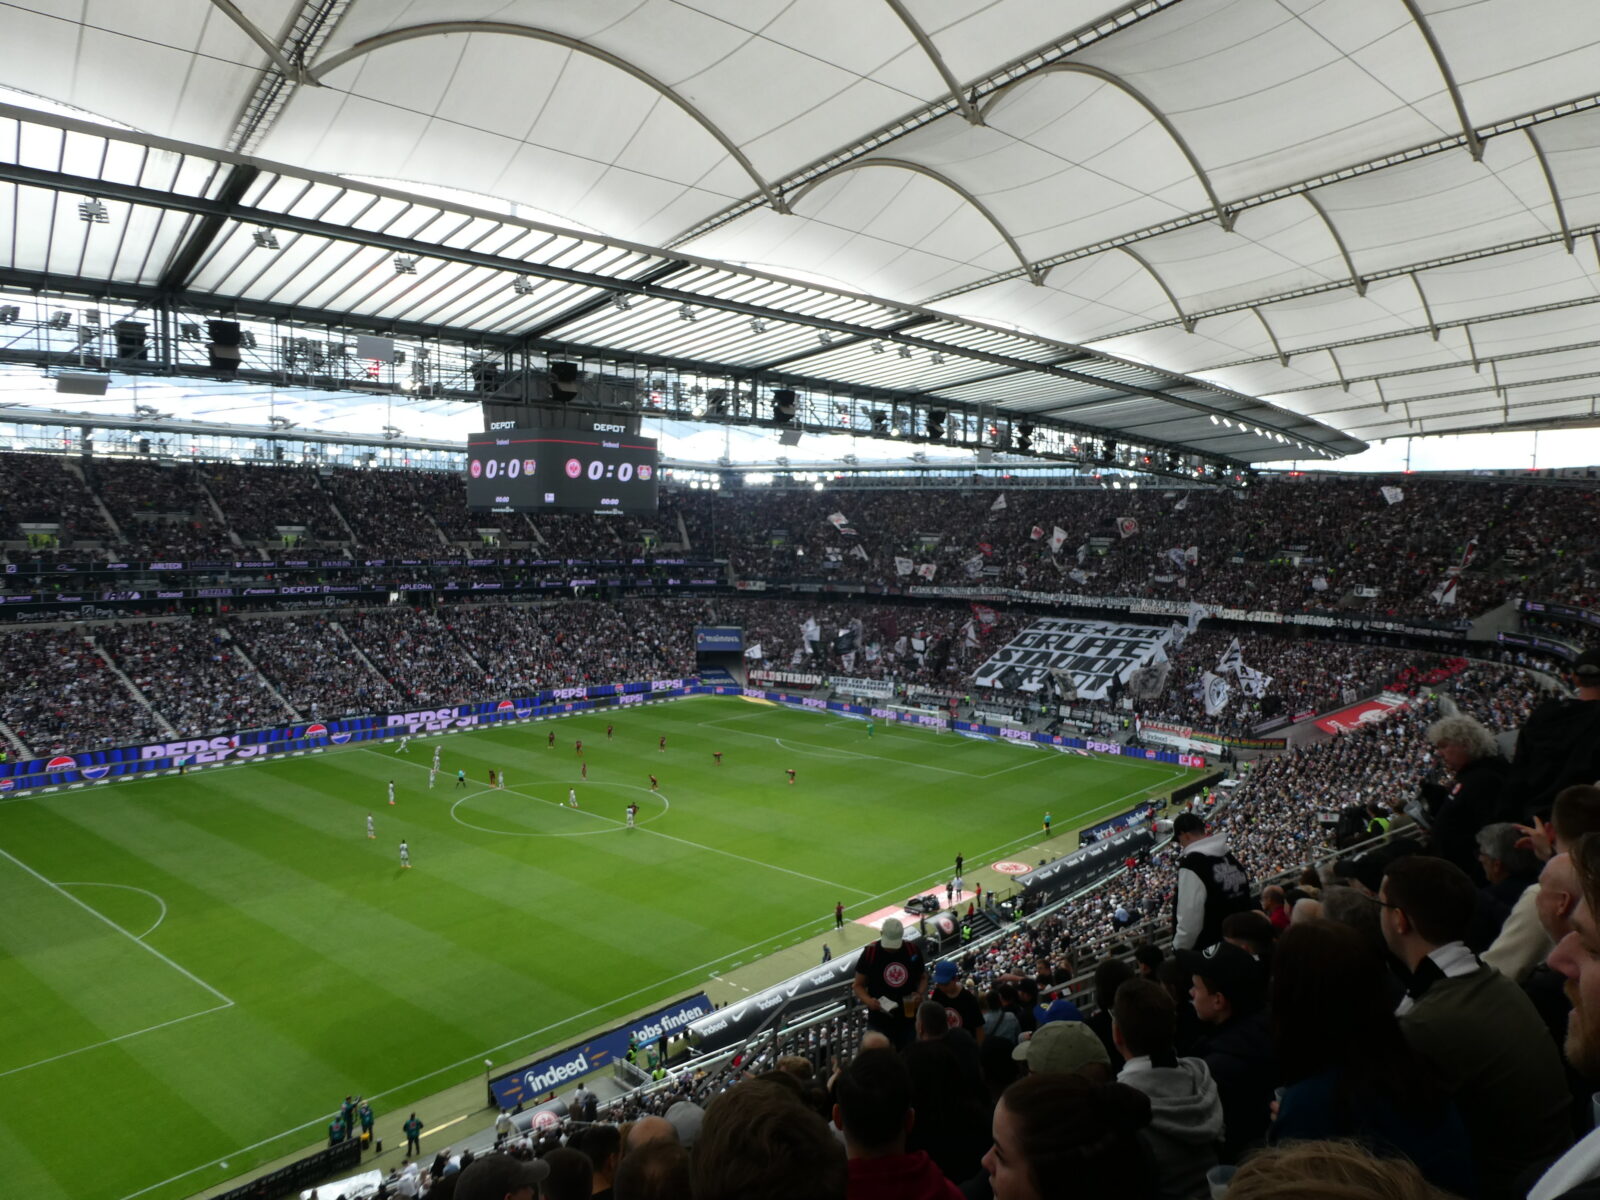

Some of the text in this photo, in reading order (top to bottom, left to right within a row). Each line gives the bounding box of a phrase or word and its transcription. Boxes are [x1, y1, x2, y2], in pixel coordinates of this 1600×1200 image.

[491, 421, 515, 430] DEPOT
[594, 423, 625, 433] DEPOT
[486, 459, 520, 478] 0:0
[588, 461, 633, 482] 0:0
[282, 586, 320, 595] DEPOT
[1028, 622, 1168, 640] EHRE DER
[1010, 632, 1153, 658] GRUPPE
[992, 649, 1133, 674] STADION
[749, 670, 822, 685] WALDSTADION
[977, 663, 1113, 691] VEROT
[652, 679, 682, 690] PEPSI
[553, 687, 586, 699] PEPSI
[619, 693, 643, 704] PEPSI
[743, 688, 765, 699] PEPSI
[802, 698, 826, 708] PEPSI
[871, 709, 897, 720] PEPSI
[918, 716, 946, 727] PEPSI
[1000, 728, 1031, 740] PEPSI
[1087, 741, 1121, 755] PEPSI
[660, 1006, 703, 1031] finden
[524, 1052, 588, 1092] indeed
